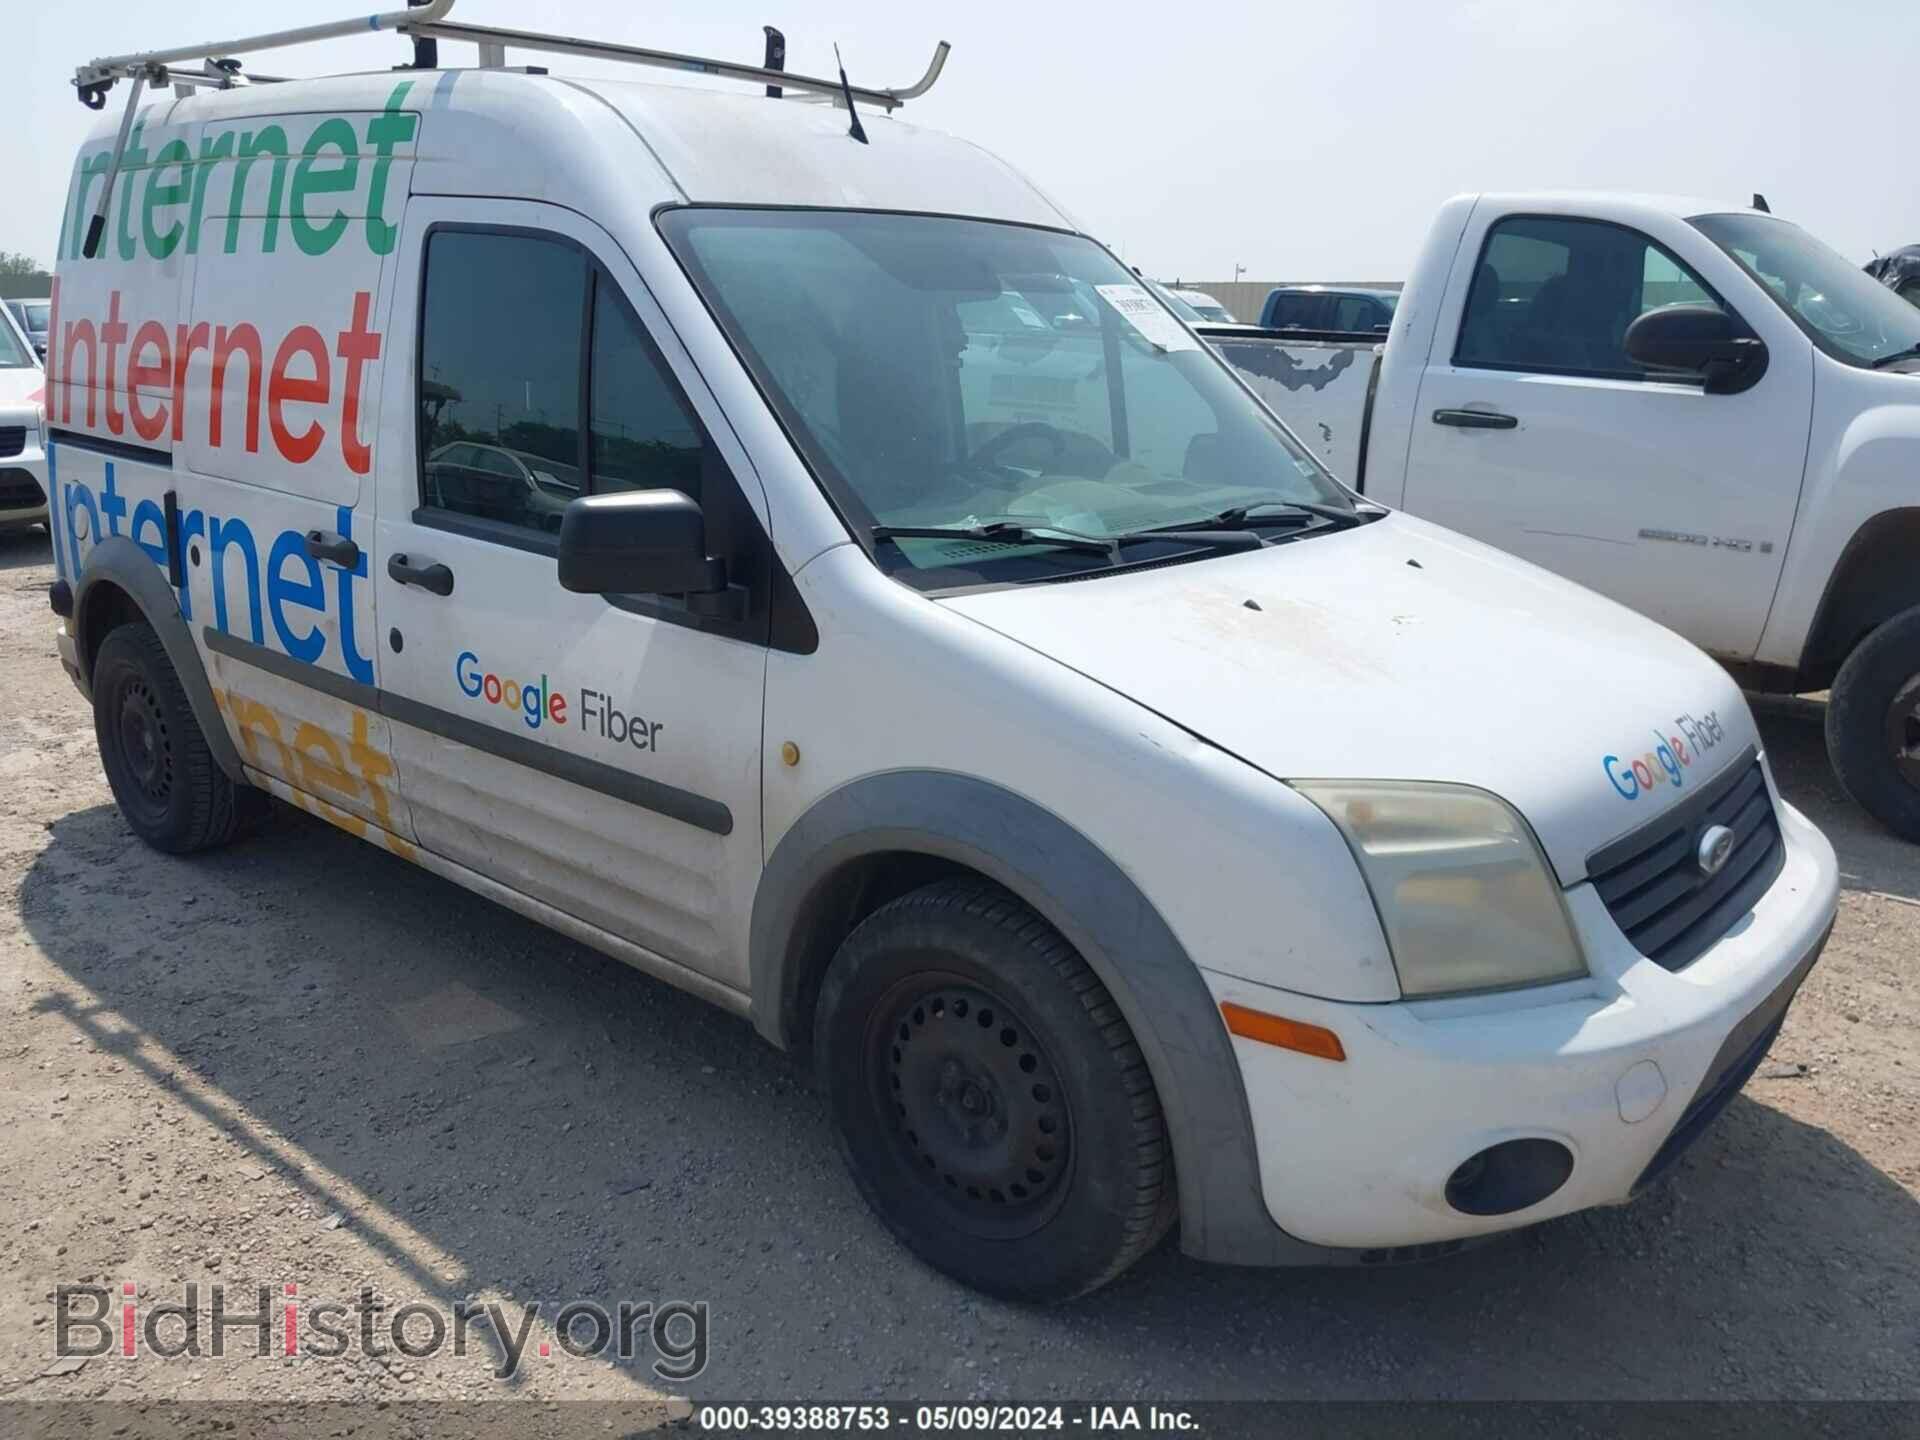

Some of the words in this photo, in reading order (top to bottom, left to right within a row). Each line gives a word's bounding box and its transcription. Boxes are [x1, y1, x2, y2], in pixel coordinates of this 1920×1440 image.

[47, 273, 382, 475] Internet
[456, 651, 567, 729] Google
[581, 688, 663, 752] Fiber
[1603, 729, 1691, 800] Google
[1675, 710, 1725, 756] Fiber
